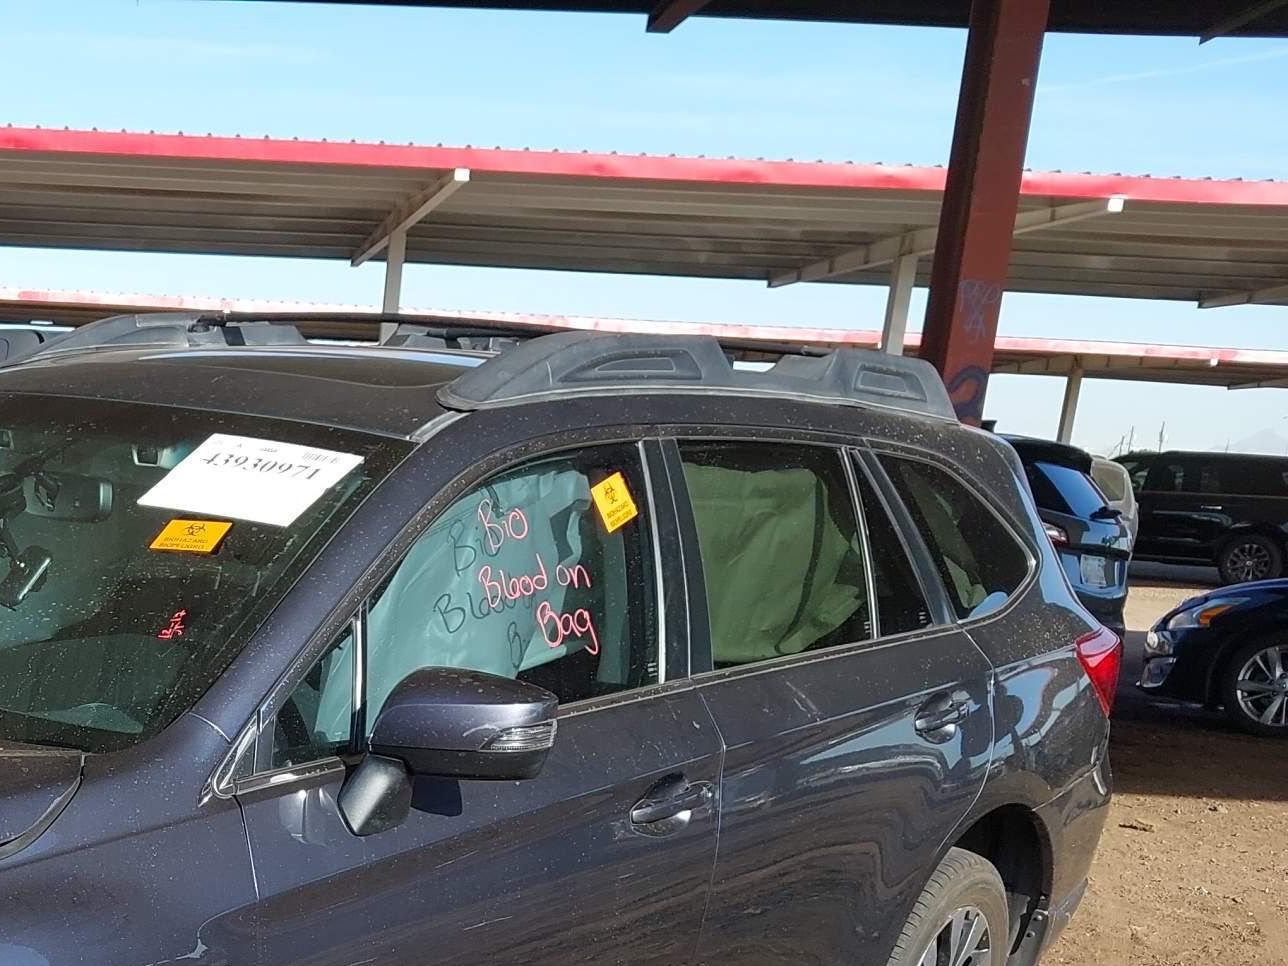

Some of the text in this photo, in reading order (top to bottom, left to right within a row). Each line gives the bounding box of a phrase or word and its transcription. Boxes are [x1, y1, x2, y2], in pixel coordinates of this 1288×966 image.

[200, 452, 322, 481] 43930971
[478, 552, 594, 609] Blood on
[535, 600, 600, 656] Bag
